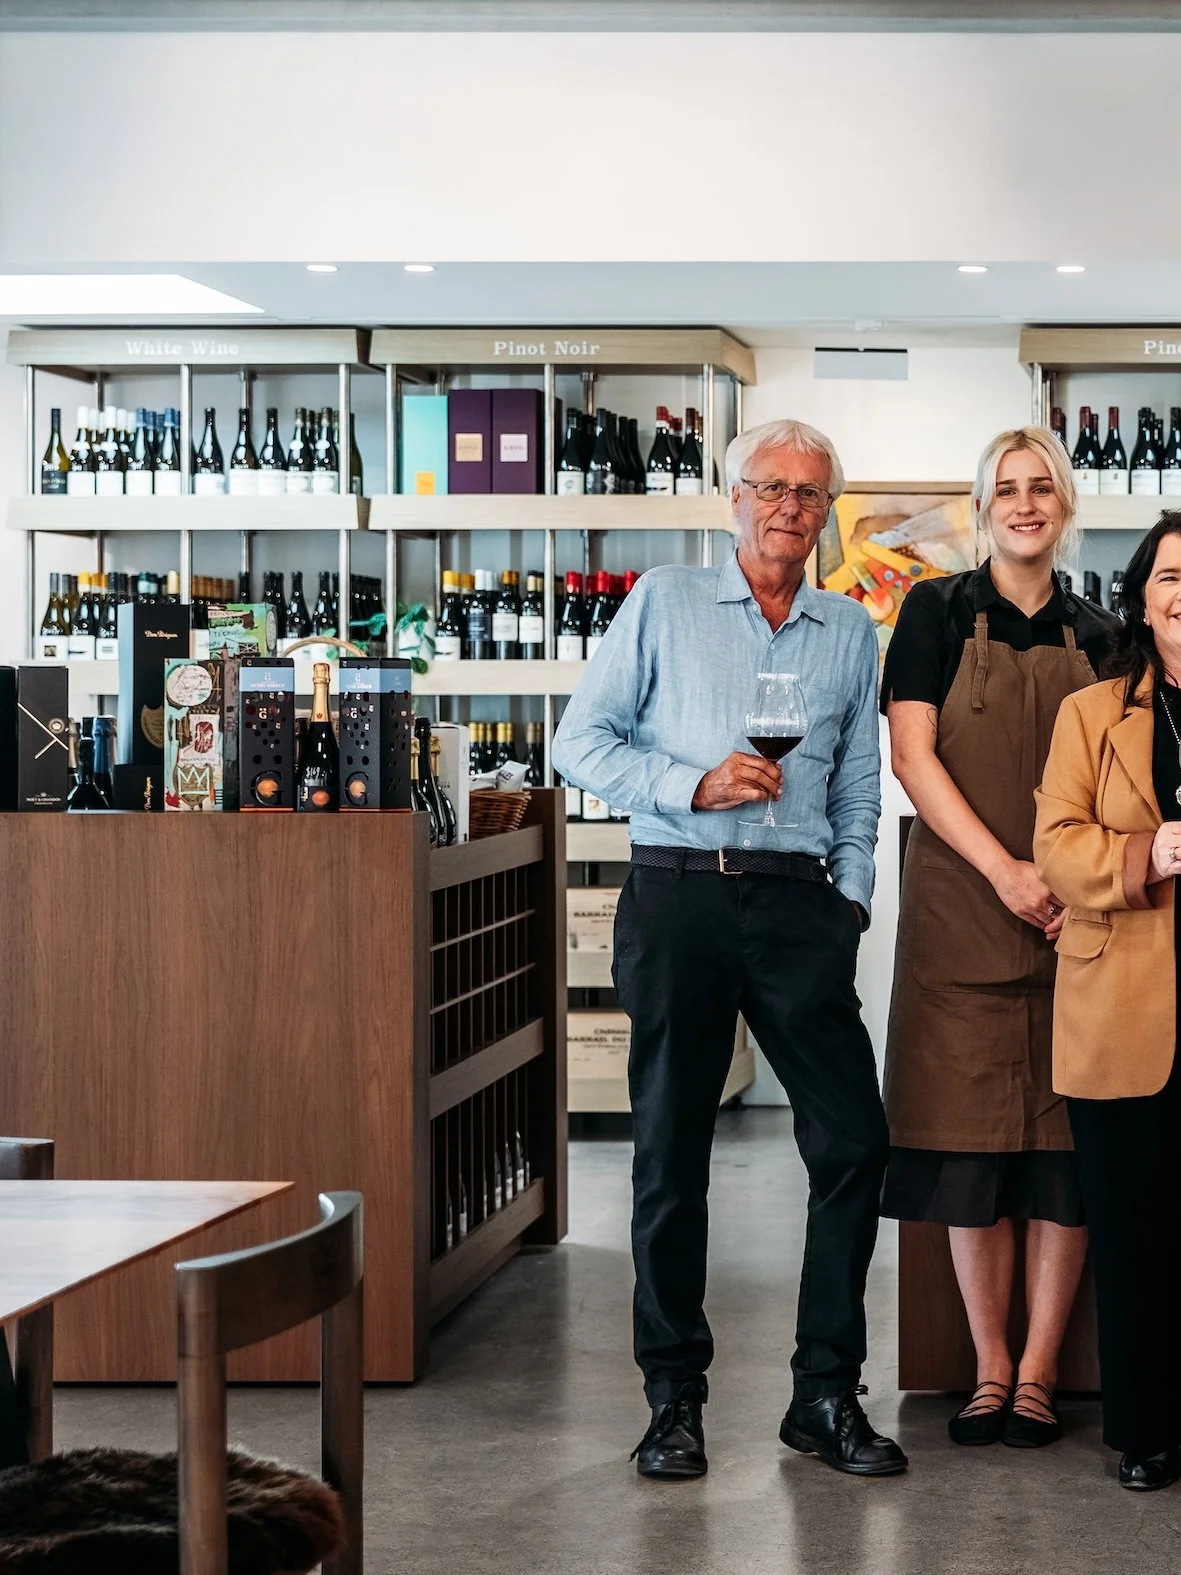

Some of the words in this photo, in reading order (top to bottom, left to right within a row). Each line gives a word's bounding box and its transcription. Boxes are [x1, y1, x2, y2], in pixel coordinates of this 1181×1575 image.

[126, 340, 182, 356] White
[191, 340, 240, 356] Wine
[493, 341, 546, 356] Pinot
[555, 341, 600, 356] Noir
